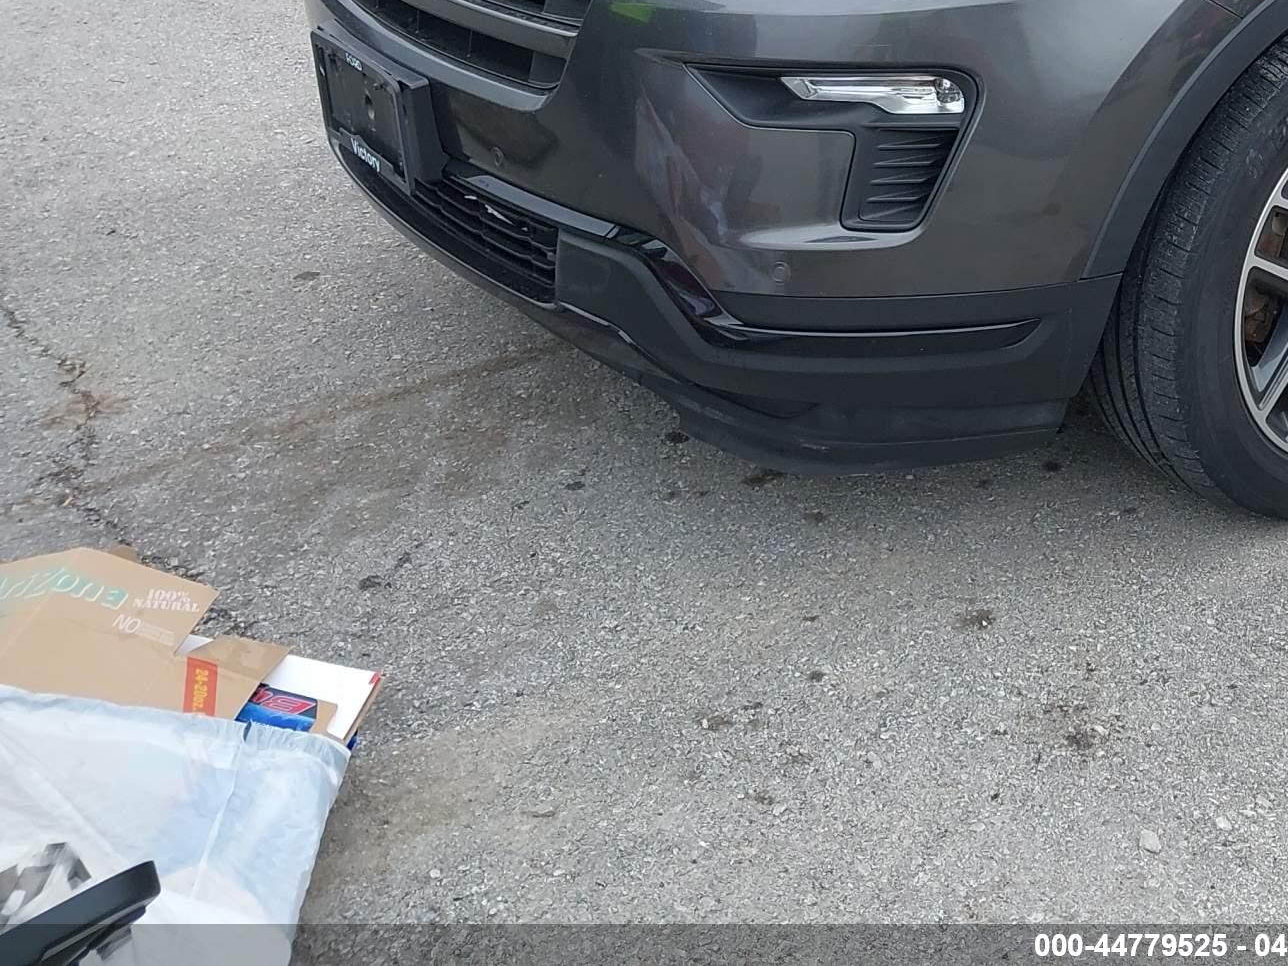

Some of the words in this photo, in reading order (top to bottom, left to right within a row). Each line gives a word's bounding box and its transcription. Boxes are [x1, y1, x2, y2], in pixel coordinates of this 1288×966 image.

[351, 137, 381, 173] Victory
[147, 588, 191, 602] 100%
[132, 597, 200, 612] NATURAL
[112, 614, 143, 634] NO
